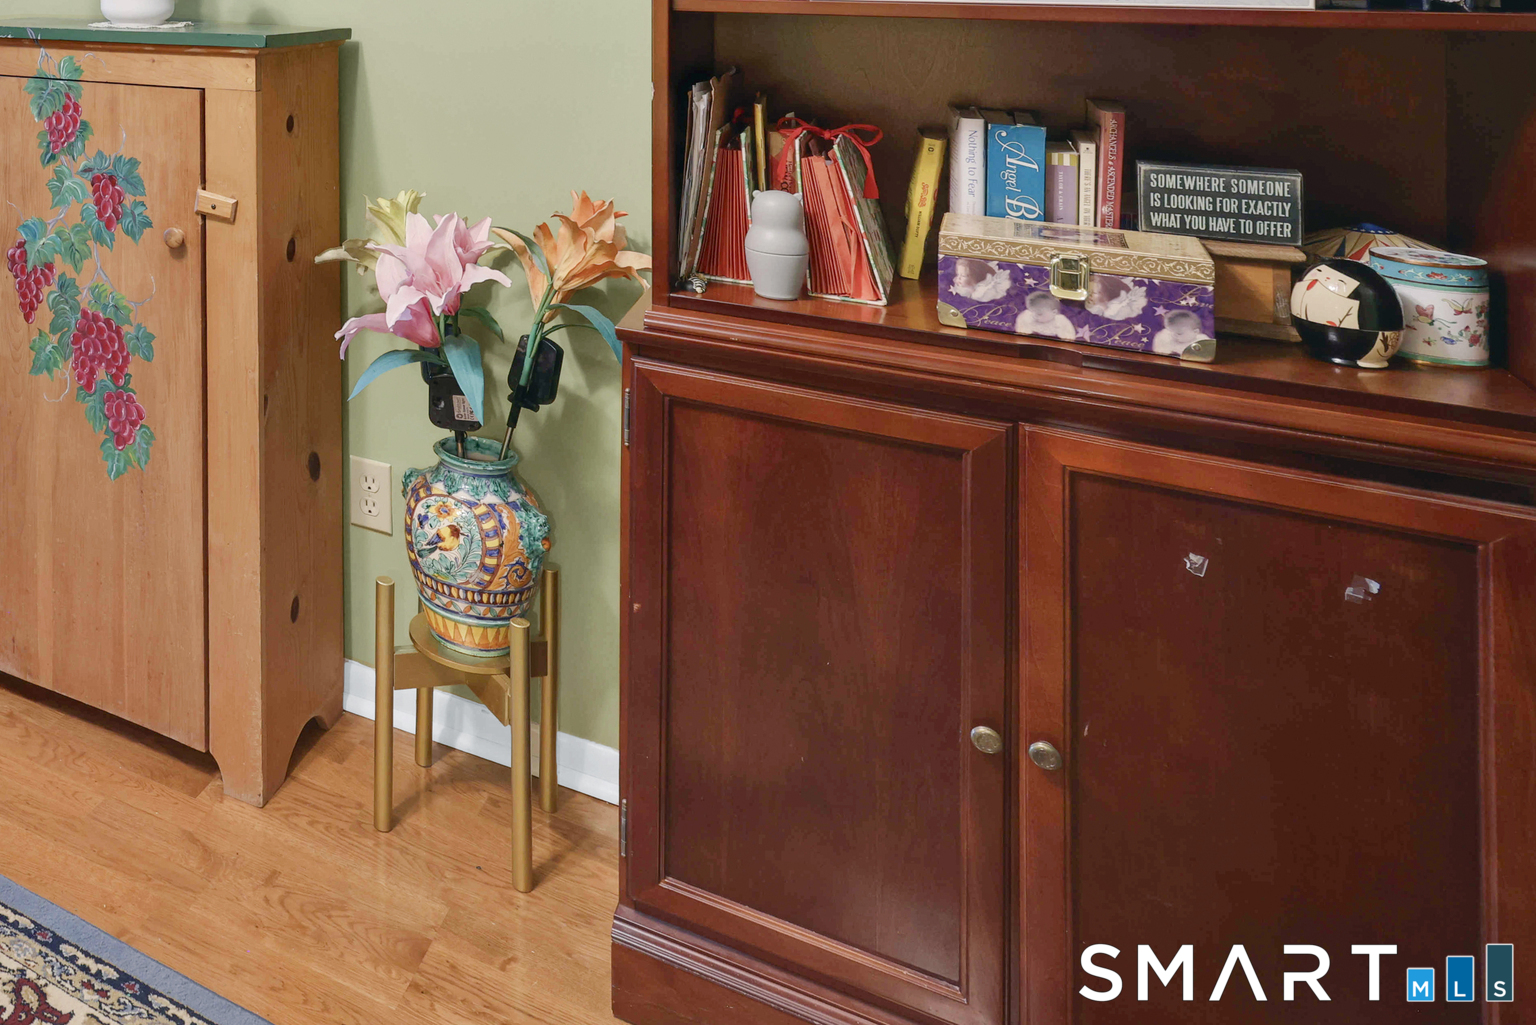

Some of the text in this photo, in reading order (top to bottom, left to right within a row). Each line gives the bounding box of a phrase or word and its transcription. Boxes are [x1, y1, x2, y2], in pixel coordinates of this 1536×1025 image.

[965, 129, 977, 164] Nothing
[1107, 118, 1117, 161] ARCHANGELS
[968, 166, 977, 176] to
[994, 129, 1039, 192] Angel
[968, 178, 978, 198] Fear
[1106, 166, 1116, 200] ASCENDED
[1150, 173, 1291, 197] SOMEWHERE SOMEONE
[1150, 192, 1292, 218] IS LOOKING FOR EXACTLY
[1150, 211, 1292, 238] WHAT YOU HAVE TO OFFER
